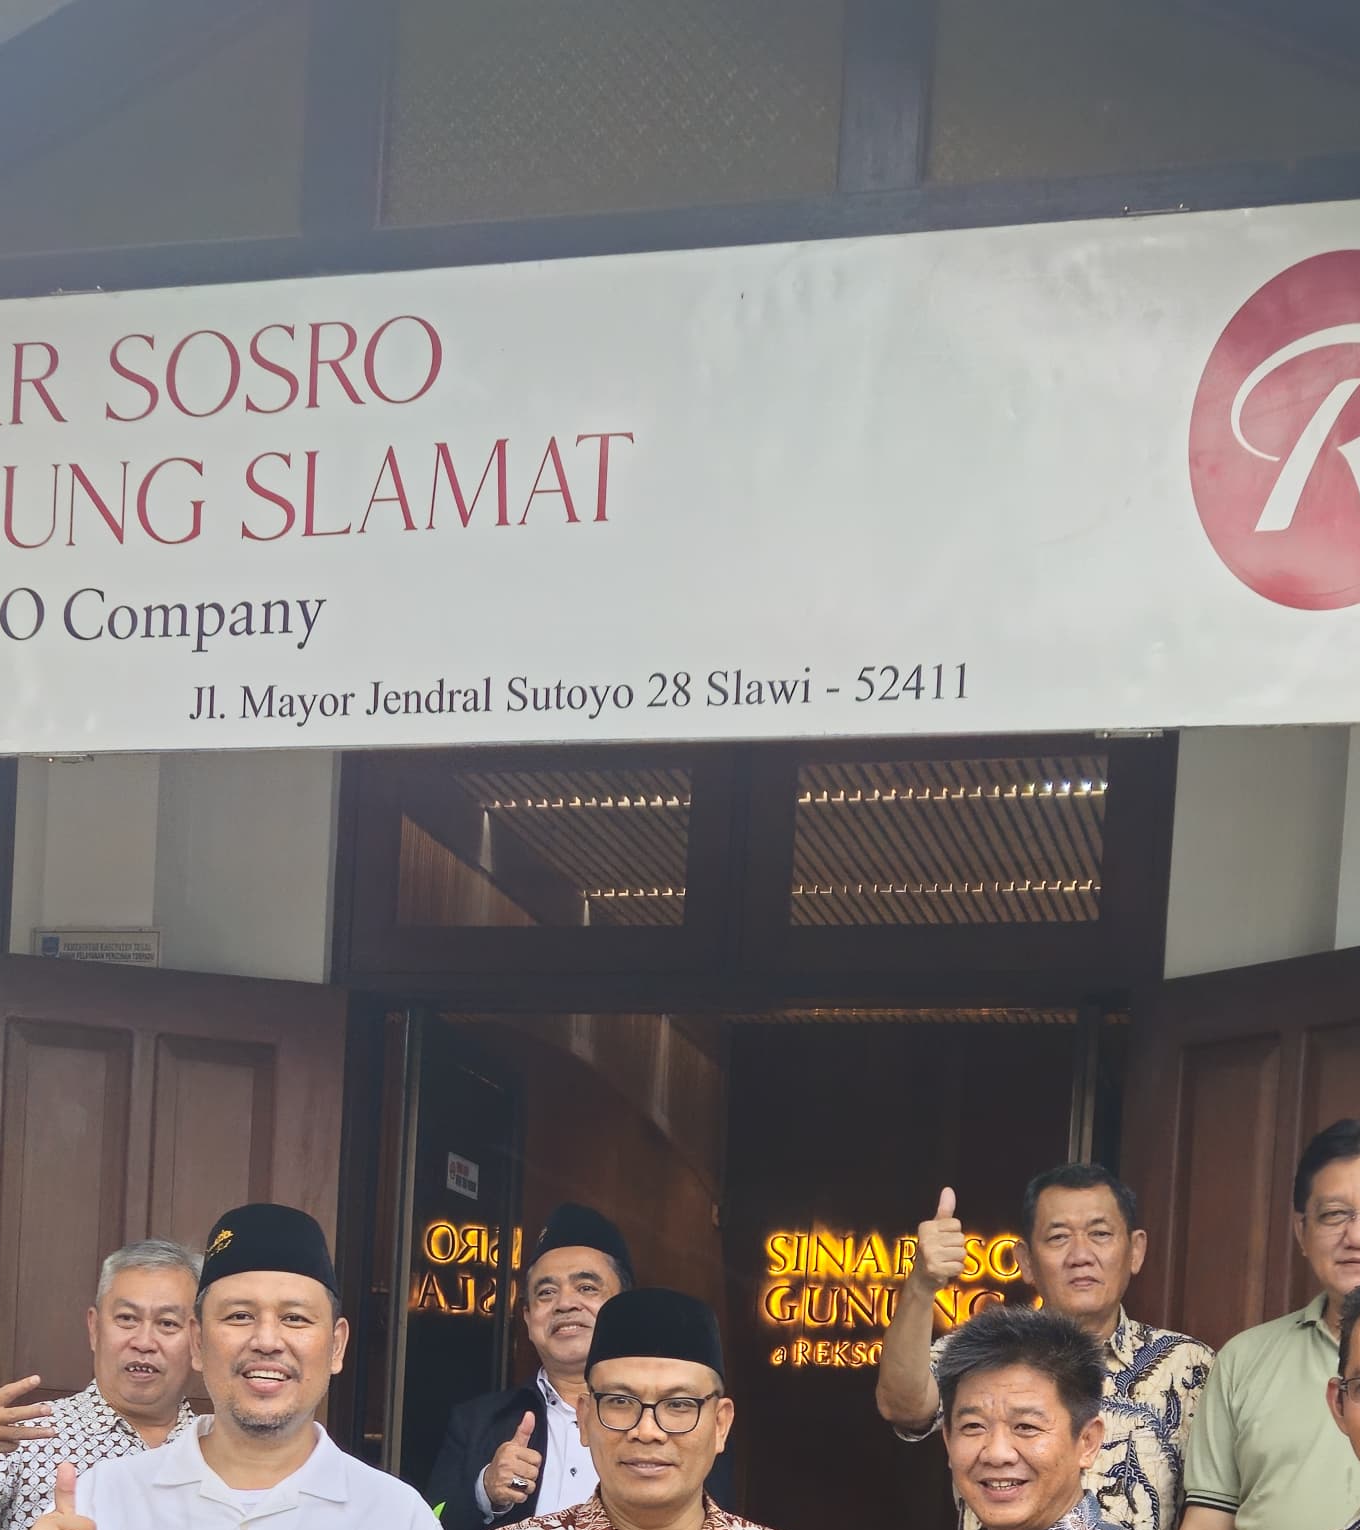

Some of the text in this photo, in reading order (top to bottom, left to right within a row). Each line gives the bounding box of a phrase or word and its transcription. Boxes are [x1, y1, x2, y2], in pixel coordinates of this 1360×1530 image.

[105, 315, 442, 422] SOSRO
[241, 432, 634, 541] SLAMAT
[63, 588, 327, 652] Company
[189, 685, 226, 719] Jl.
[239, 684, 356, 728] Mayor
[365, 676, 492, 716] Jendral
[506, 675, 634, 719] Sutoyo
[647, 671, 692, 708] 28
[706, 667, 812, 706] Slawi
[854, 662, 969, 702] 52411
